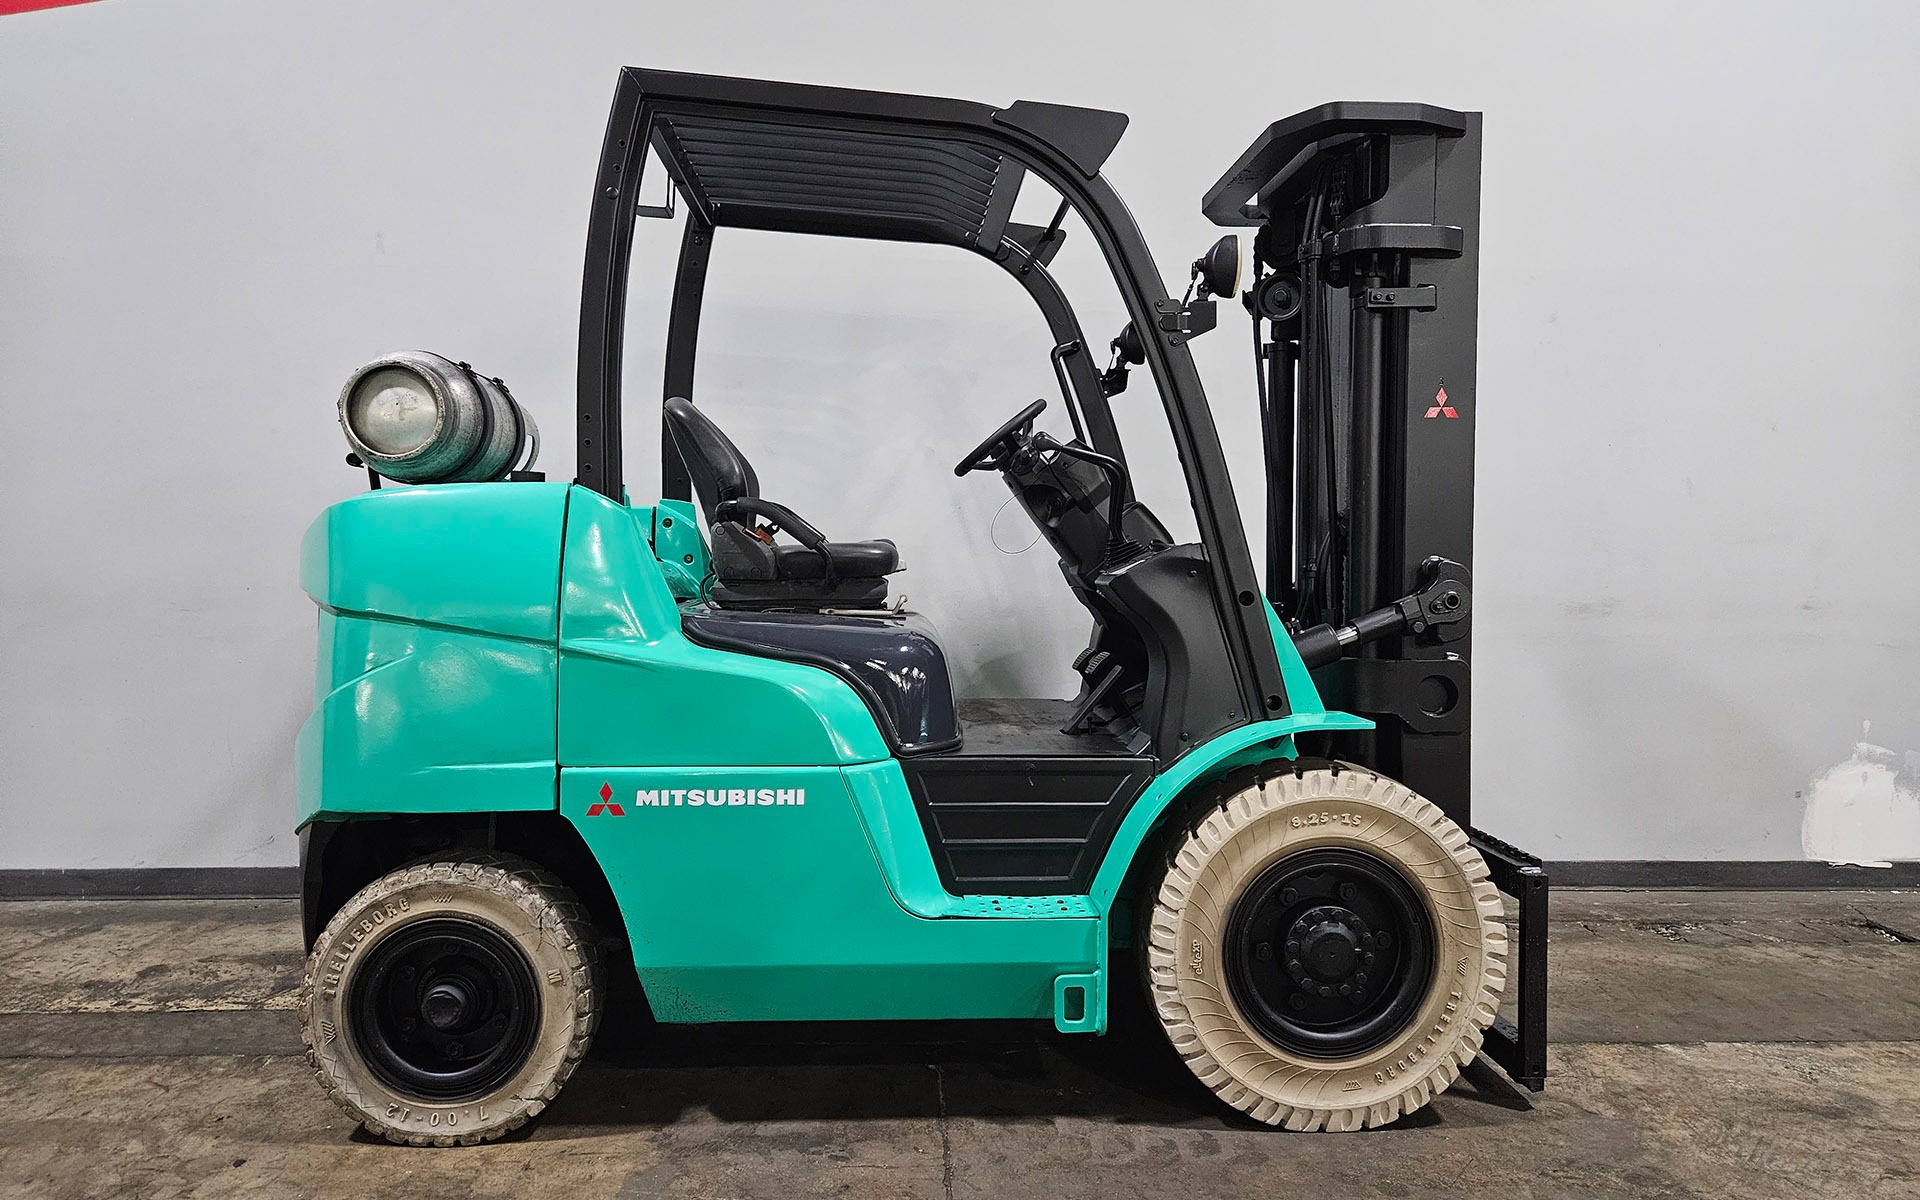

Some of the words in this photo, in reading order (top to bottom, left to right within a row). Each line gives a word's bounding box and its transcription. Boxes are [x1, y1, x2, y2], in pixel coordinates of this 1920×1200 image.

[635, 788, 805, 806] MITSUBISHI
[322, 896, 411, 996] TRELLEBORG
[1374, 991, 1463, 1084] TRELLEBORG
